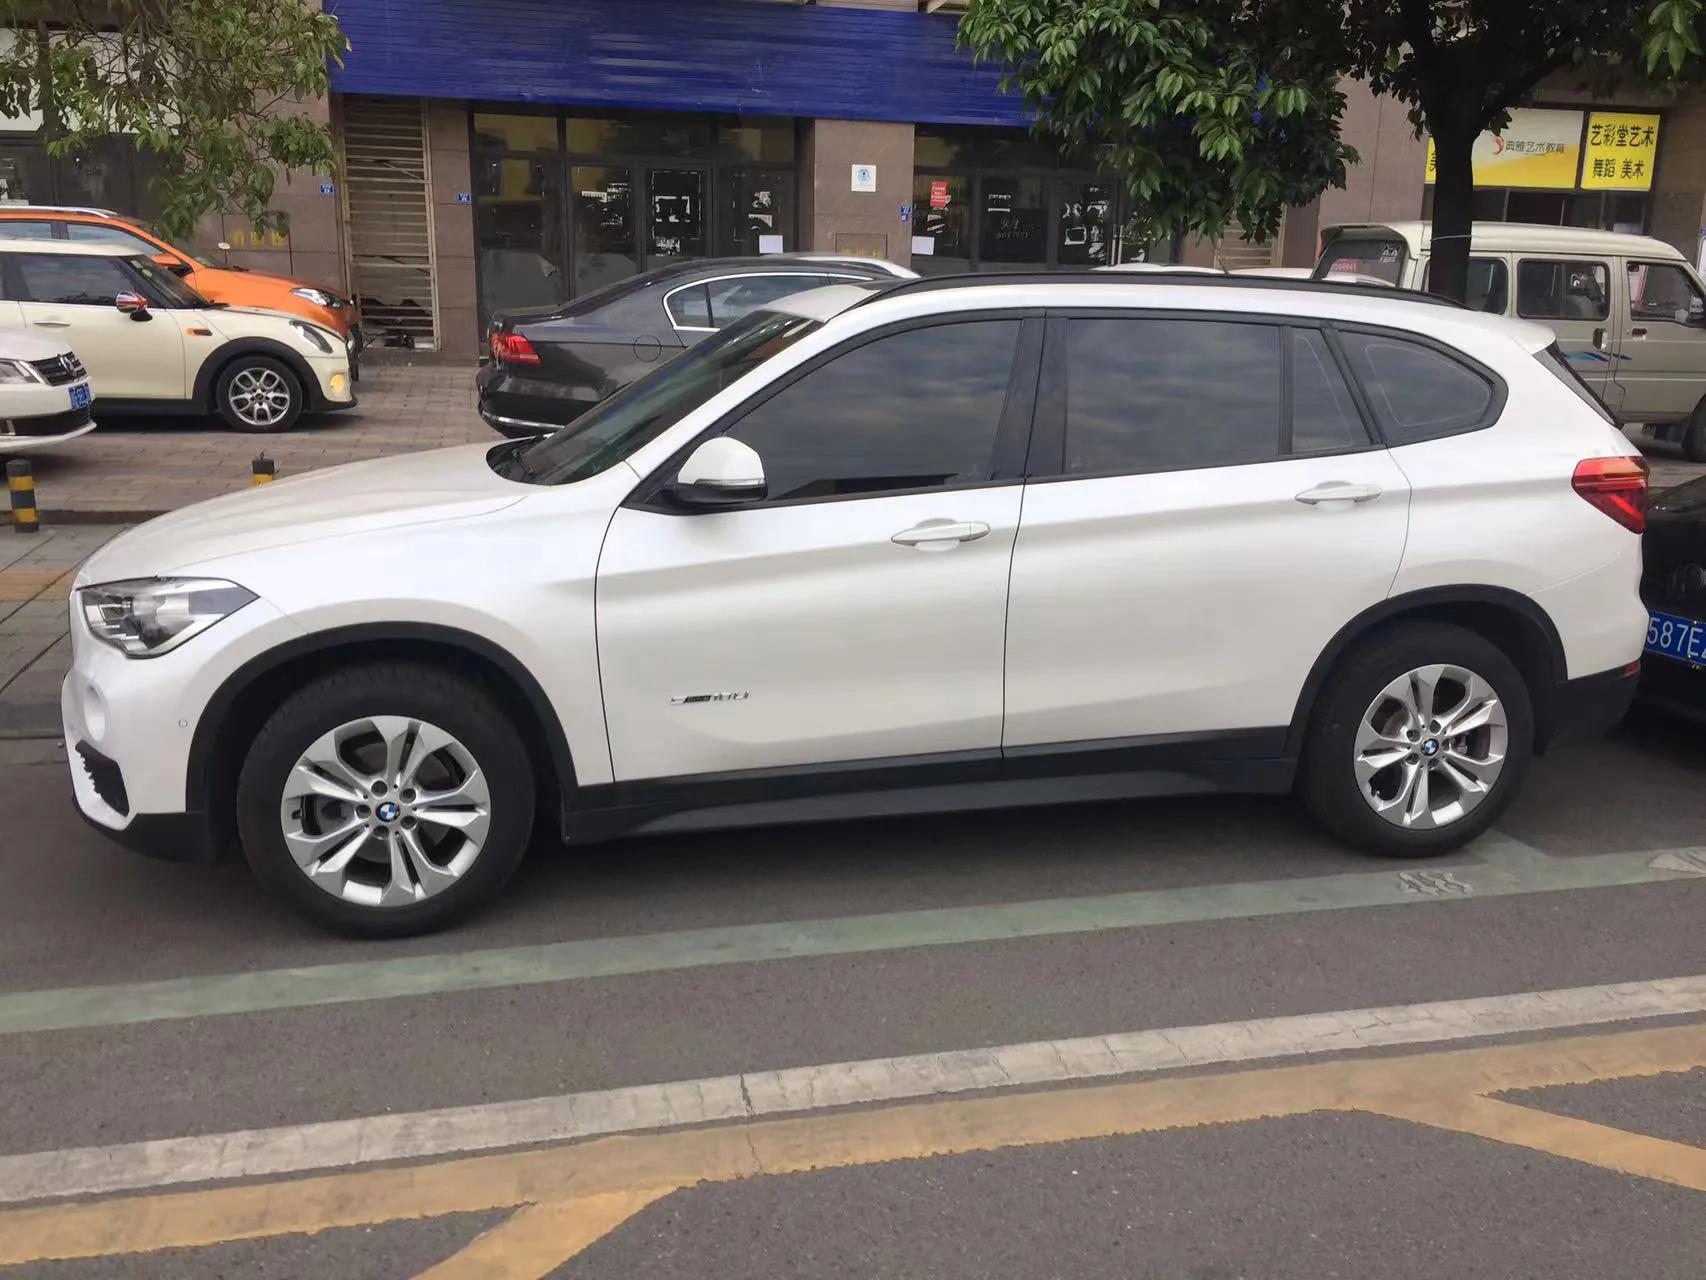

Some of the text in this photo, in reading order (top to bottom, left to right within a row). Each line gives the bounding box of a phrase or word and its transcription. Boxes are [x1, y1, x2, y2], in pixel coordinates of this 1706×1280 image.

[1591, 123, 1654, 147] 艺彩堂艺术
[1592, 158, 1645, 180] 舞蹈 美术
[1647, 616, 1706, 659] 587E
